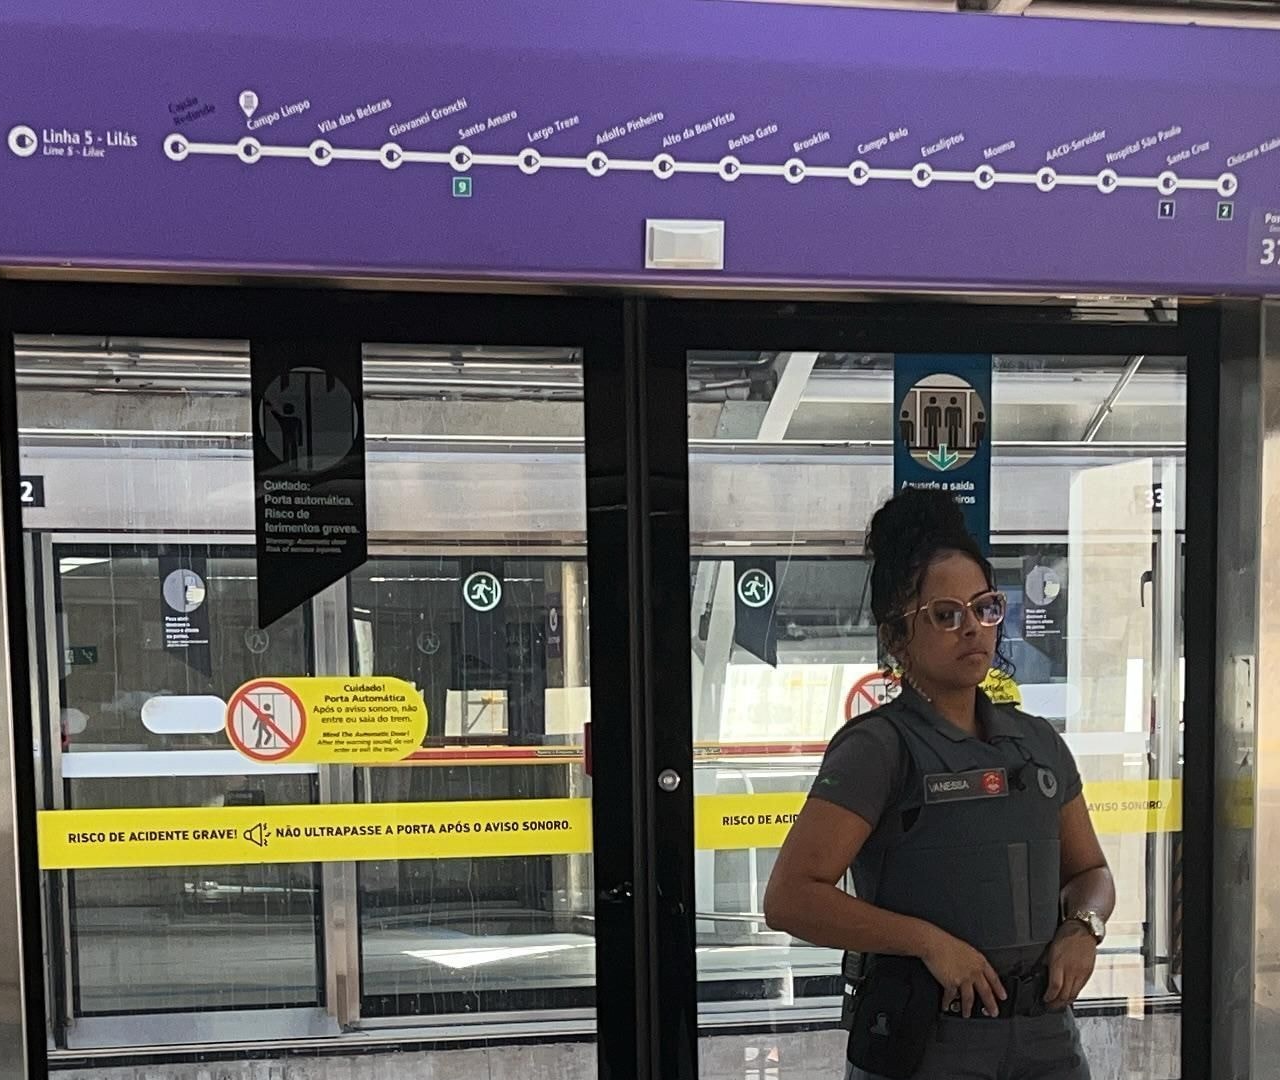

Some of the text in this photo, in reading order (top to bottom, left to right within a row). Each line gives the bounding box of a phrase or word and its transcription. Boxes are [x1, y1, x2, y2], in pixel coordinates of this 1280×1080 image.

[246, 100, 311, 131] Campo Limpo
[317, 98, 393, 135] Vila das Belezas
[388, 97, 468, 137] Giovanni Gronchi
[458, 109, 518, 140] Santo Amaro
[43, 129, 138, 147] Linha 5 Lilás
[527, 115, 580, 144] Largo Treze
[596, 111, 664, 145] Adolfo Pinheiro
[662, 111, 736, 148] Alto da Boa Vista
[728, 123, 778, 150] Borba Gato
[793, 130, 830, 153] Brooklin
[857, 127, 909, 155] Campo Belo
[921, 132, 965, 157] Eucaliptos
[1046, 129, 1106, 162] AACD-Servidor
[264, 493, 354, 506] Porta automática.
[265, 508, 310, 519] Risco de
[265, 522, 321, 533] ferimentos
[325, 694, 406, 703] Porta Automática
[344, 684, 385, 692] Cuidado!
[313, 705, 335, 713] Após
[345, 705, 366, 713] aviso
[369, 706, 400, 714] sonoro,
[402, 704, 418, 712] não
[359, 715, 375, 723] saia
[377, 715, 388, 723] do
[390, 715, 412, 723] trem.
[1088, 802, 1118, 812] AVISO
[69, 820, 573, 843] RISCO DE ACIDENTE GRAVE! NÃO ULTRAPASSE A PORTA APÓS O AVISO SONORO.
[722, 815, 755, 826] RISCO
[758, 815, 772, 825] DE
